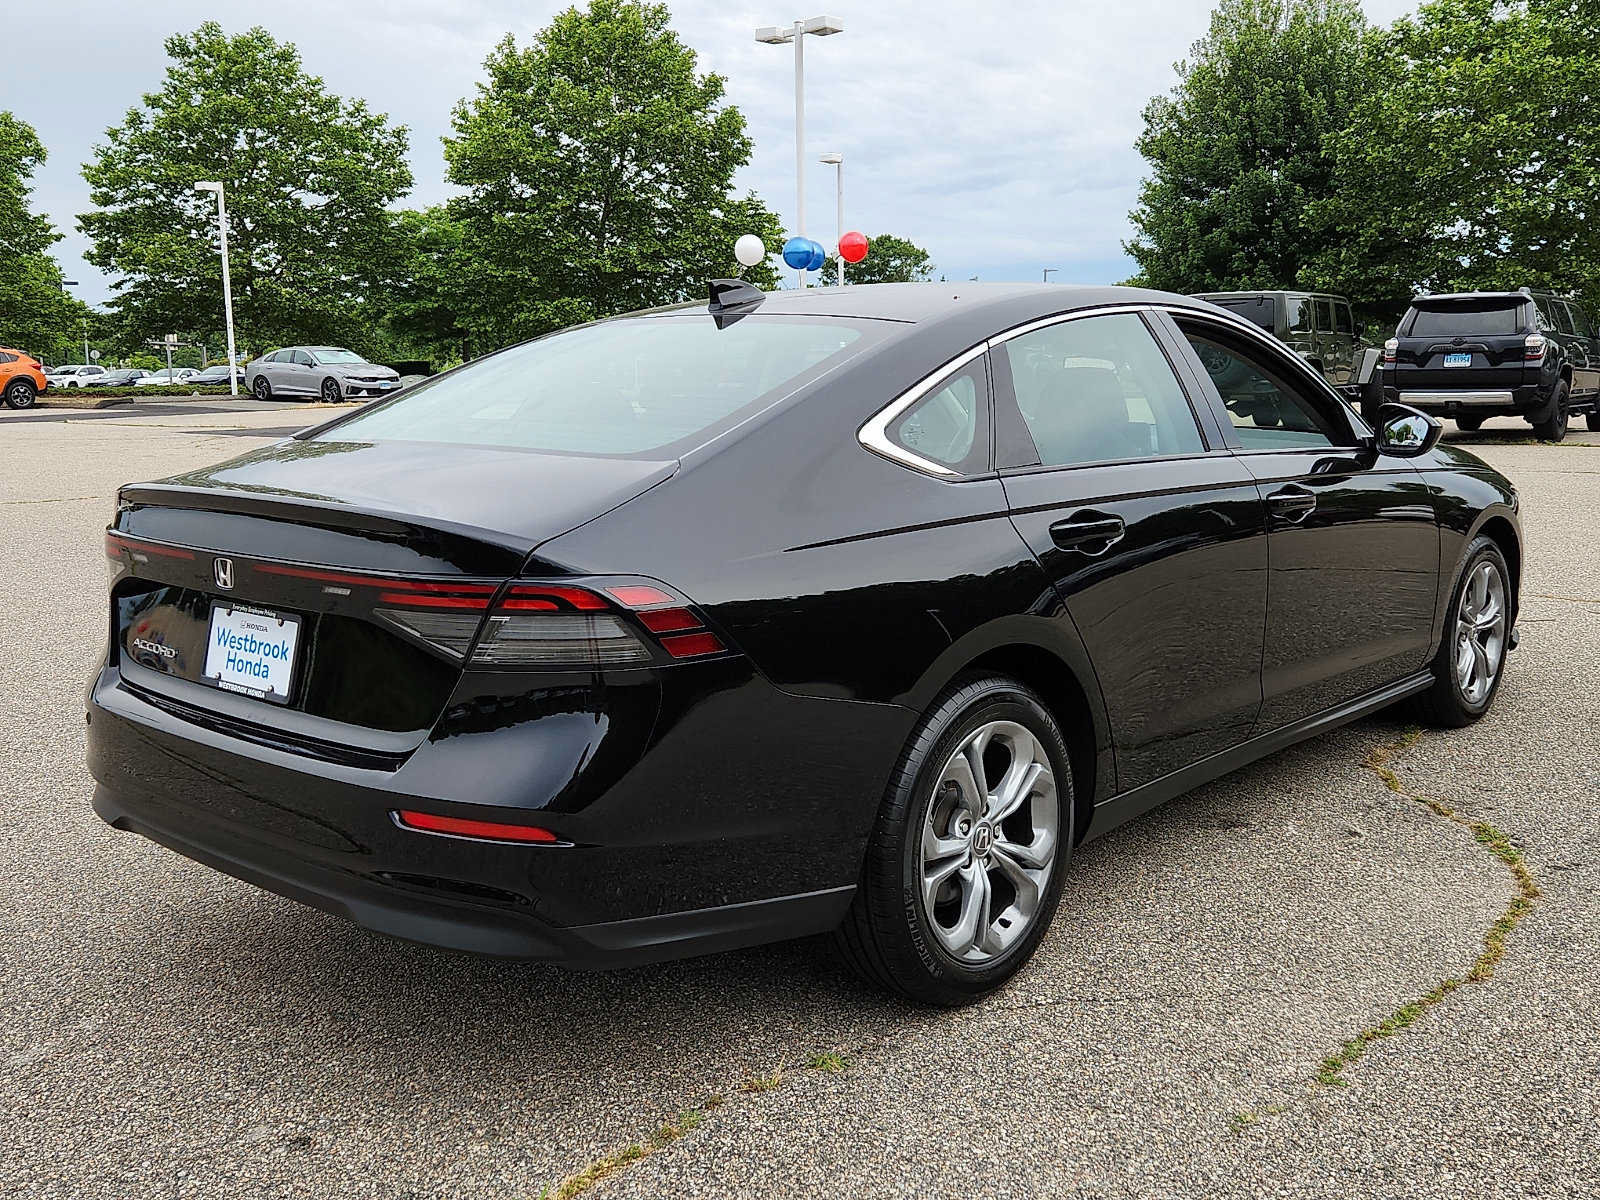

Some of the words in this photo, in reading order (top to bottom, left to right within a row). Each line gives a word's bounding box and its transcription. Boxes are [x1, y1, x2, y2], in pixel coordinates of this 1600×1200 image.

[246, 622, 268, 632] HONDA
[132, 638, 175, 658] ACCORD
[217, 626, 289, 662] Westbrook
[225, 650, 269, 679] Honda
[218, 680, 248, 694] WESTBROOK
[247, 688, 265, 699] HONDA
